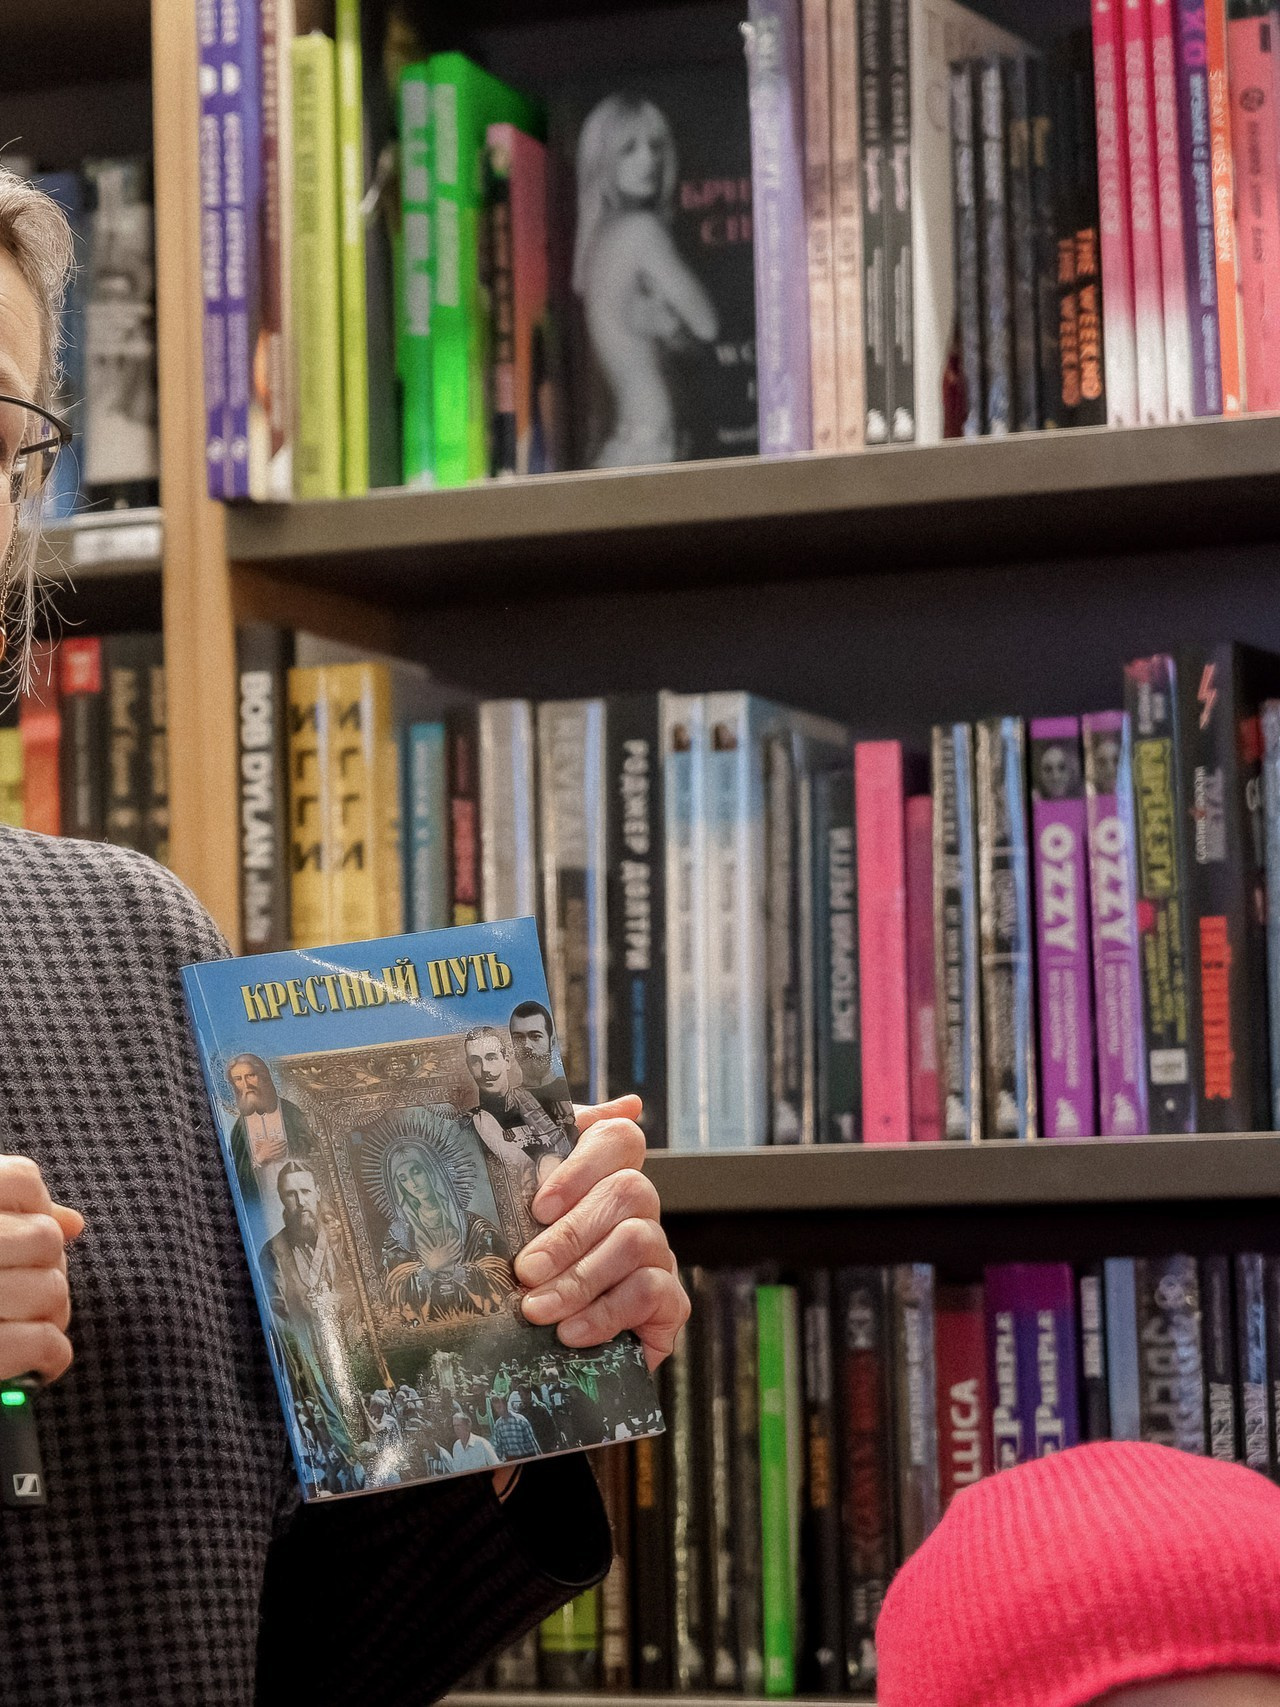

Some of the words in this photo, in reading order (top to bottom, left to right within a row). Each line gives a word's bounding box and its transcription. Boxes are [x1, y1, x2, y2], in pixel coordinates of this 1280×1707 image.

[1209, 69, 1225, 127] STRAY
[1058, 238, 1076, 280] THE
[1076, 228, 1097, 278] THE
[1060, 294, 1081, 407] WEEKND
[1077, 285, 1103, 400] WEEKND
[241, 672, 273, 749] BOB
[241, 753, 275, 867] DYLAN
[293, 703, 322, 872] ИГГИ
[336, 703, 365, 872] ИГГИ
[555, 716, 584, 860] REVEAL
[621, 740, 650, 854] РОДЖЕР
[620, 862, 651, 970] ДОЛТРИ
[828, 828, 854, 910] РЕГГИ
[1041, 821, 1078, 952] OZZY
[1096, 817, 1132, 948] OZZY
[239, 956, 419, 1022] КРЕСТНЫЙ
[427, 951, 513, 998] ПУТЬ
[830, 914, 856, 1042] ИСТОРИЯ
[994, 1310, 1022, 1437] PURPLE
[1035, 1309, 1064, 1434] PURPLE
[949, 1378, 983, 1492] LLICA
